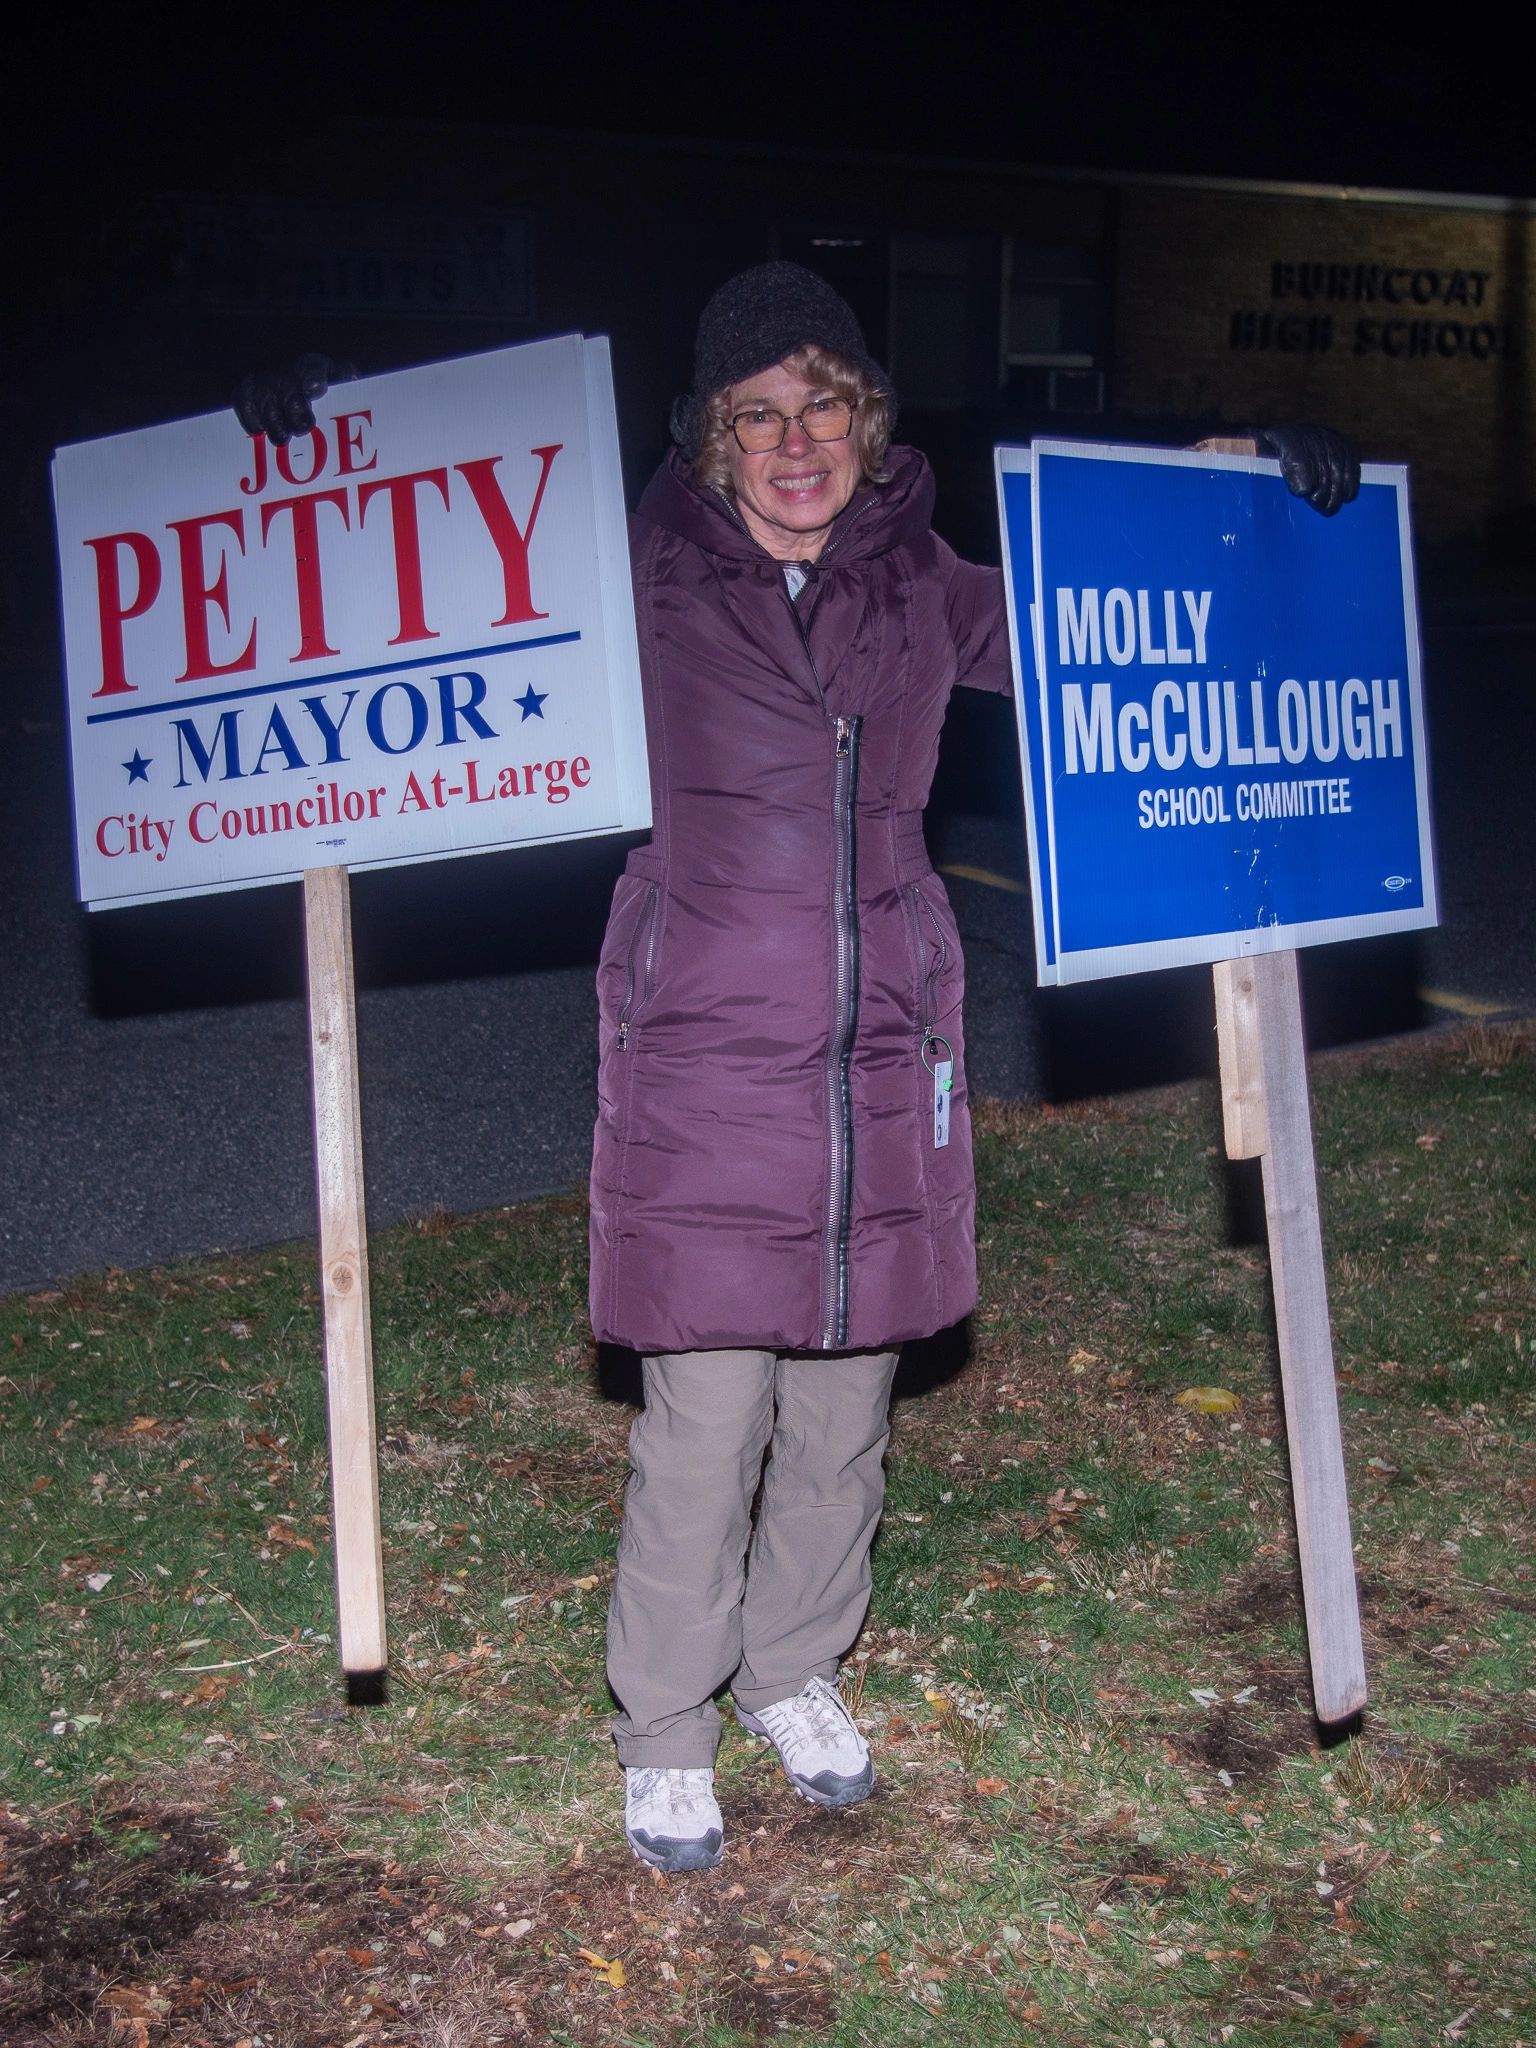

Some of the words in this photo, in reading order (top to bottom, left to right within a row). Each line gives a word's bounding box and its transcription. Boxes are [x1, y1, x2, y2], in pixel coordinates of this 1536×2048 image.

[1271, 259, 1491, 307] BURNCOAT
[1229, 308, 1333, 353] HIGH
[240, 410, 378, 495] JOE
[83, 444, 564, 698] PETTY
[1056, 587, 1212, 666] MOLLY
[171, 671, 499, 788] MAYOR
[1062, 679, 1404, 775] McCULLOUGH
[96, 812, 175, 862] City
[188, 782, 386, 844] Councilor
[400, 758, 592, 813] At-Large
[1138, 783, 1231, 829] SCHOOL
[1236, 777, 1352, 823] COMMITTEE
